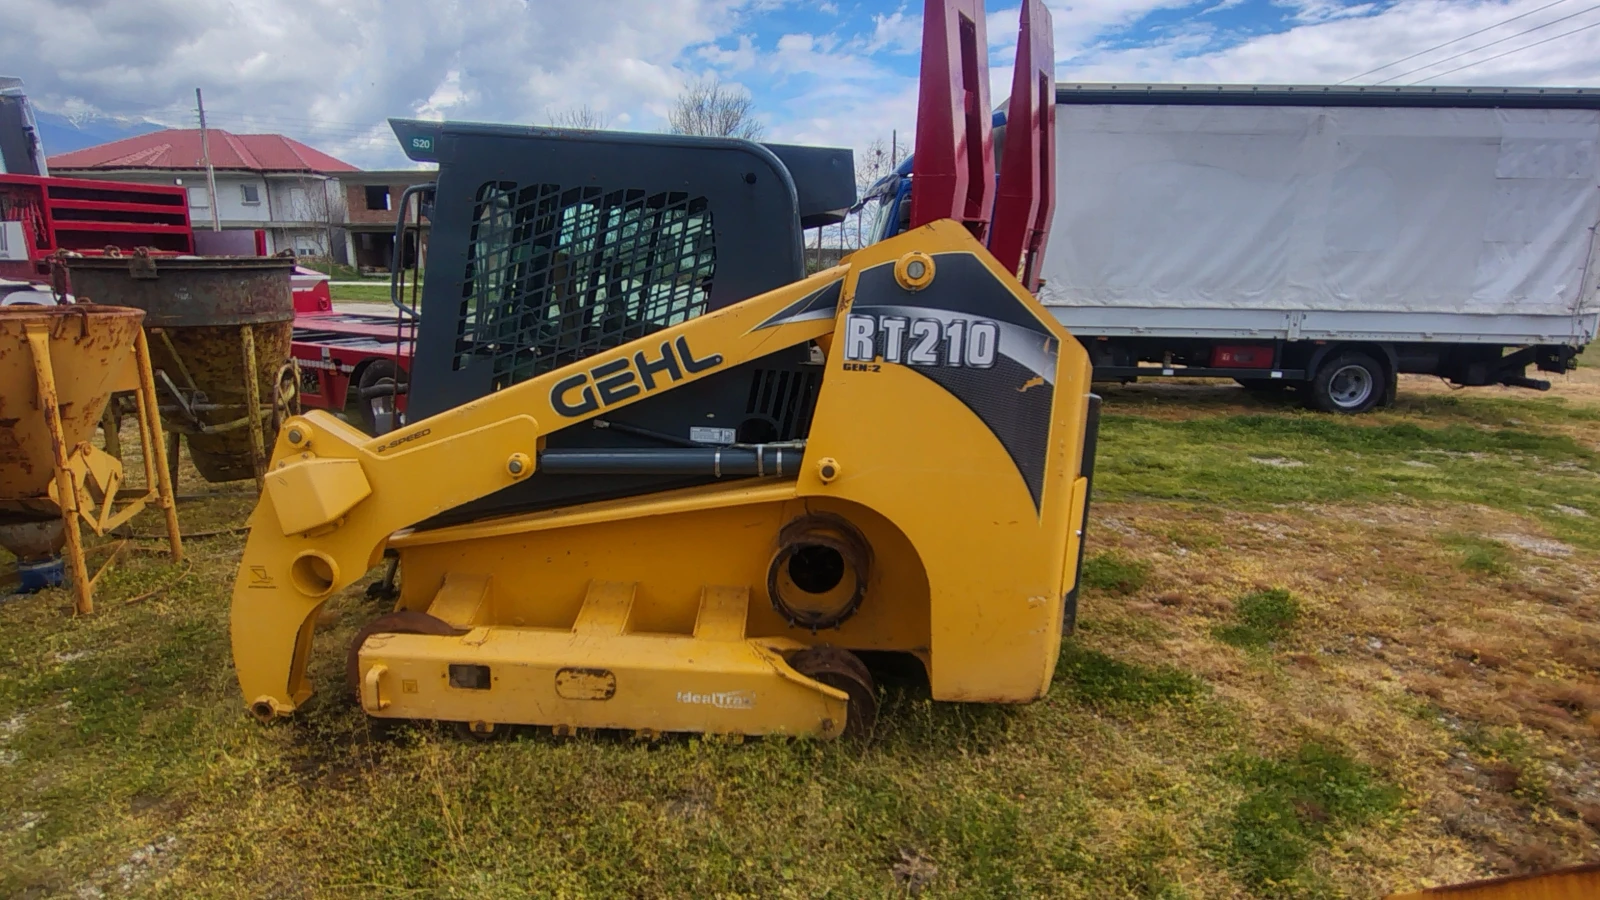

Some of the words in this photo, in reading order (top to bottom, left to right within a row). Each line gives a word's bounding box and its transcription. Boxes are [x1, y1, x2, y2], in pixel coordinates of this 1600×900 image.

[412, 138, 430, 149] S20
[845, 313, 1000, 369] RT210
[549, 335, 723, 417] GEHL
[377, 428, 431, 453] 2-SPEED
